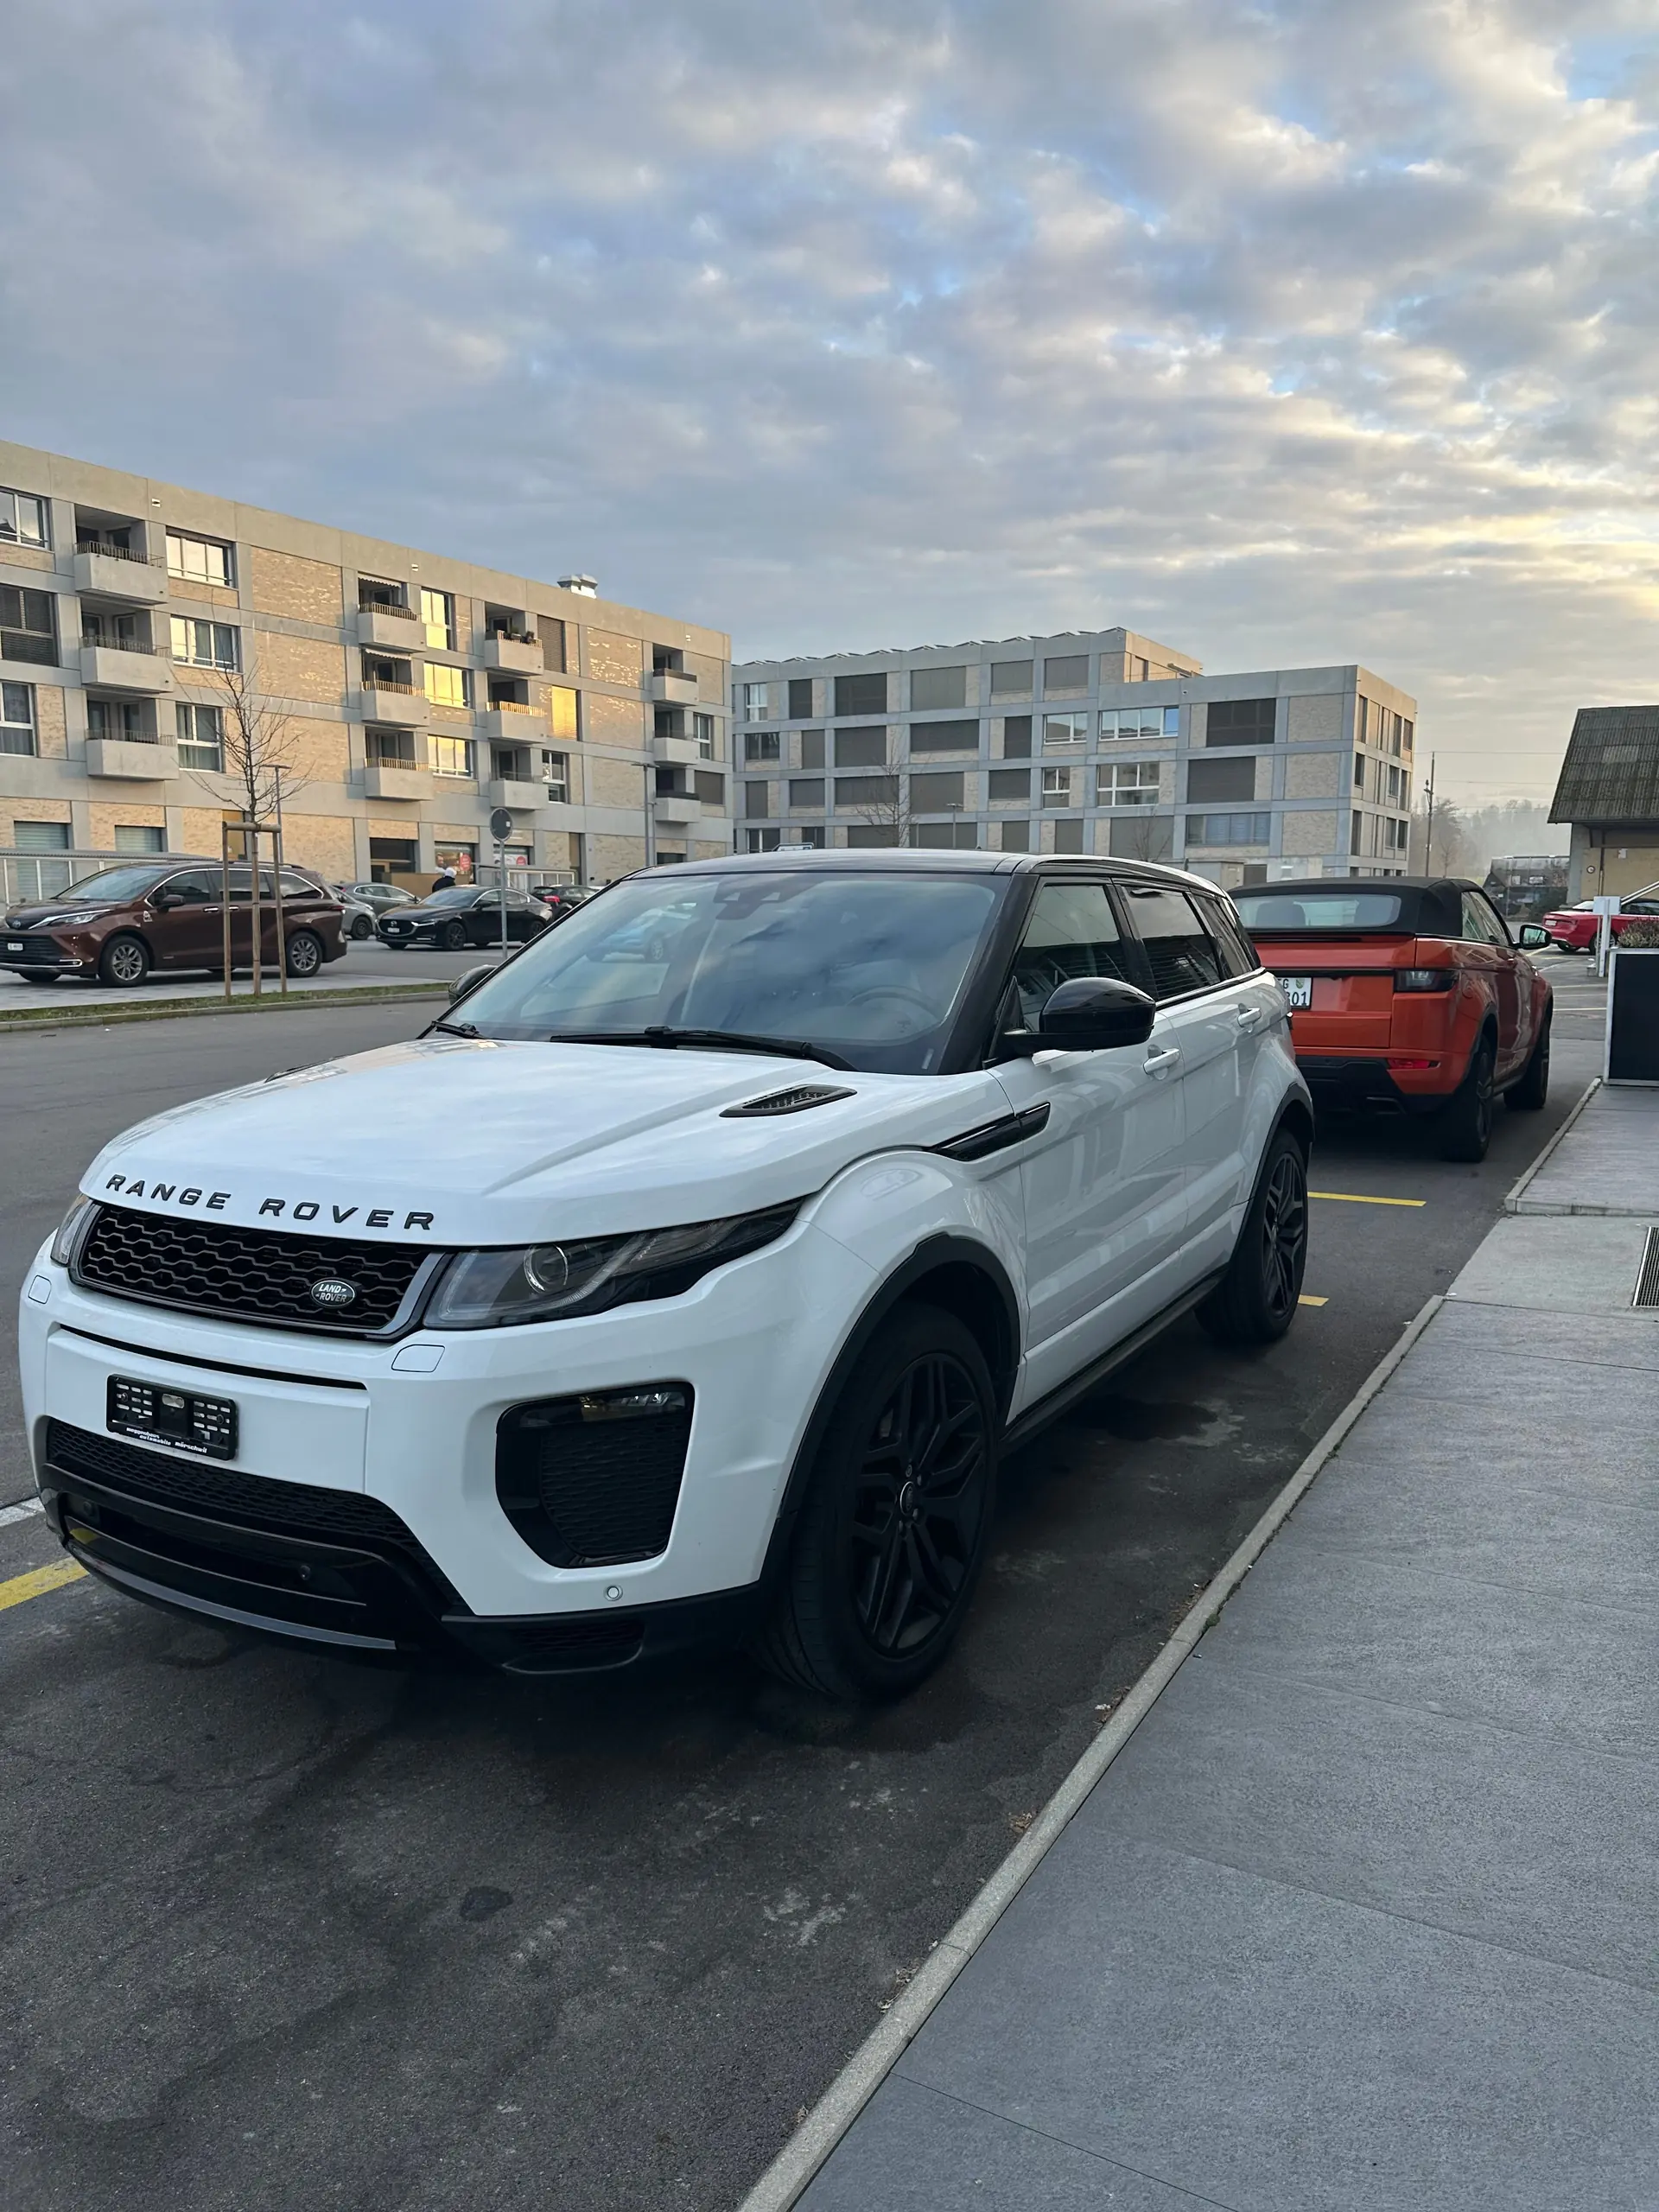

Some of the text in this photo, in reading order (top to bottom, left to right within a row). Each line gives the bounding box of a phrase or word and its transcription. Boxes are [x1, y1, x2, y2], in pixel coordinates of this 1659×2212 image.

[105, 1174, 435, 1230] RANGE ROVER
[319, 1284, 342, 1294] LAND
[319, 1293, 347, 1302] ROVER
